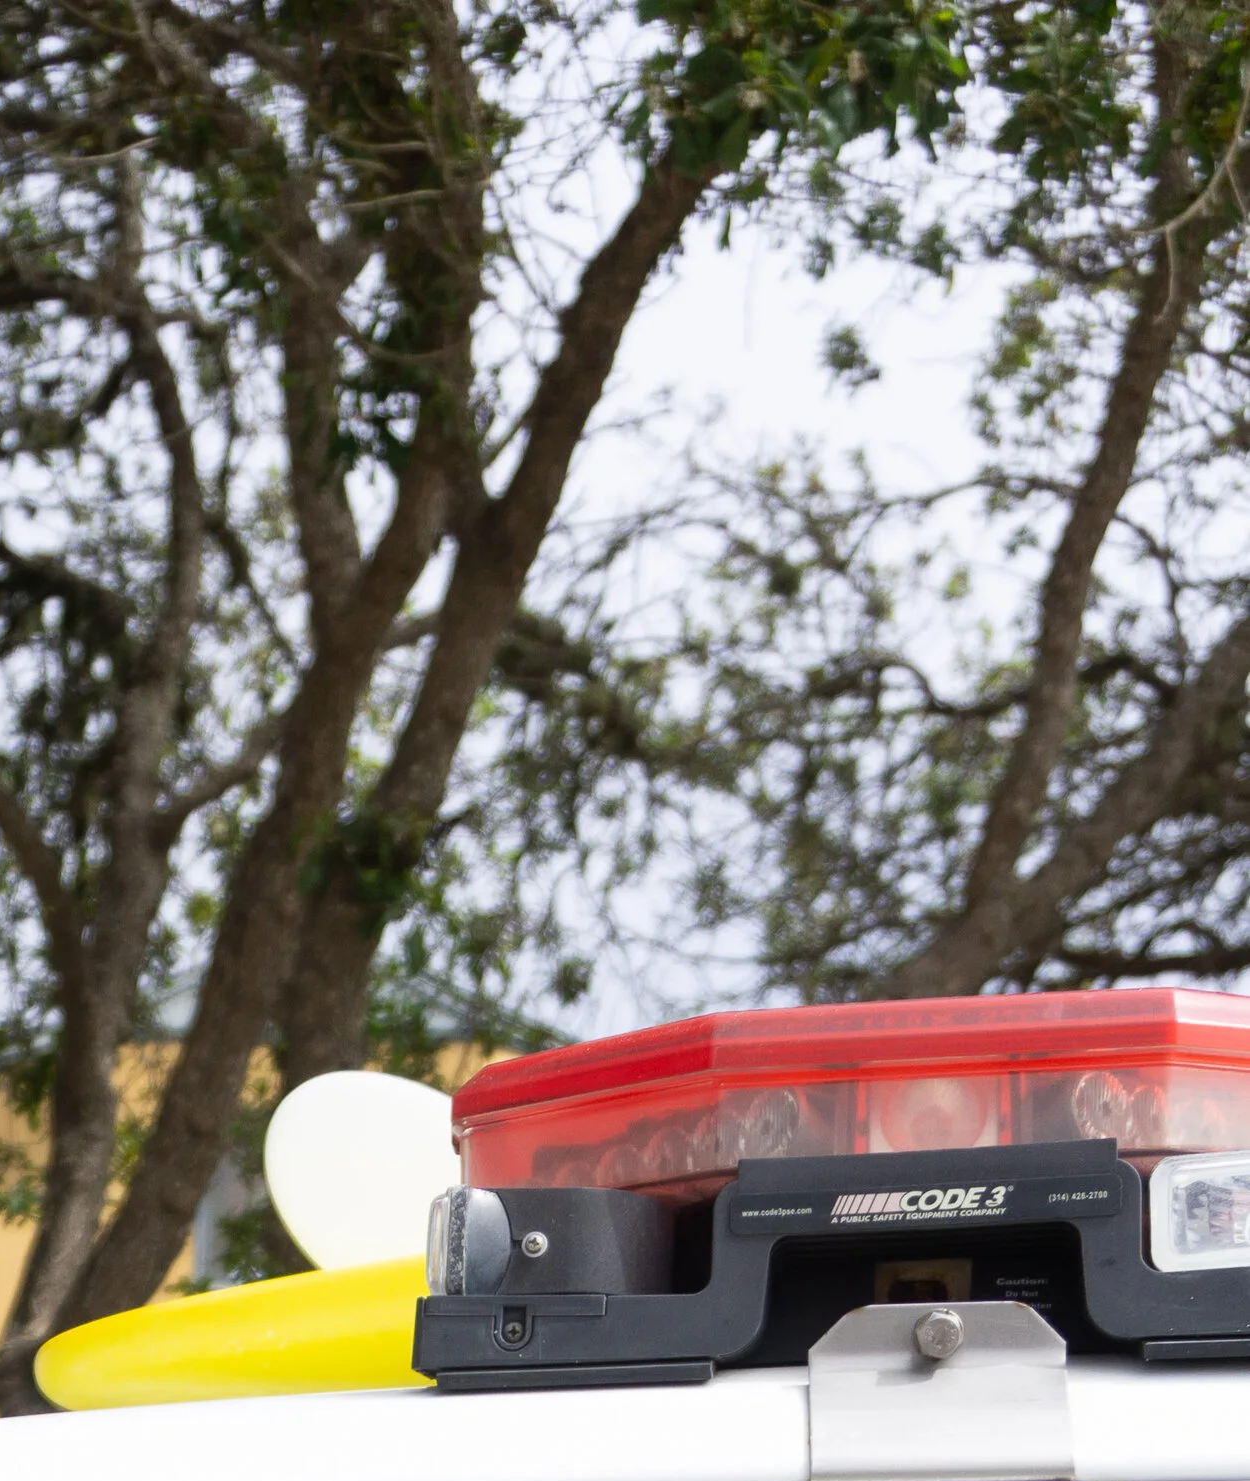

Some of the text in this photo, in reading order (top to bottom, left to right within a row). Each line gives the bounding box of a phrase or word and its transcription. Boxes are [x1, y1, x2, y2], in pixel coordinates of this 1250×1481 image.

[900, 1186, 986, 1212] CODE
[1048, 1193, 1069, 1203] (314)
[741, 1207, 812, 1217] www.code3pse.com
[840, 1215, 870, 1223] PUBLIC
[872, 1213, 903, 1222] SAFETY
[906, 1211, 958, 1220] EQUIPMENT
[959, 1207, 1007, 1216] COMPANY
